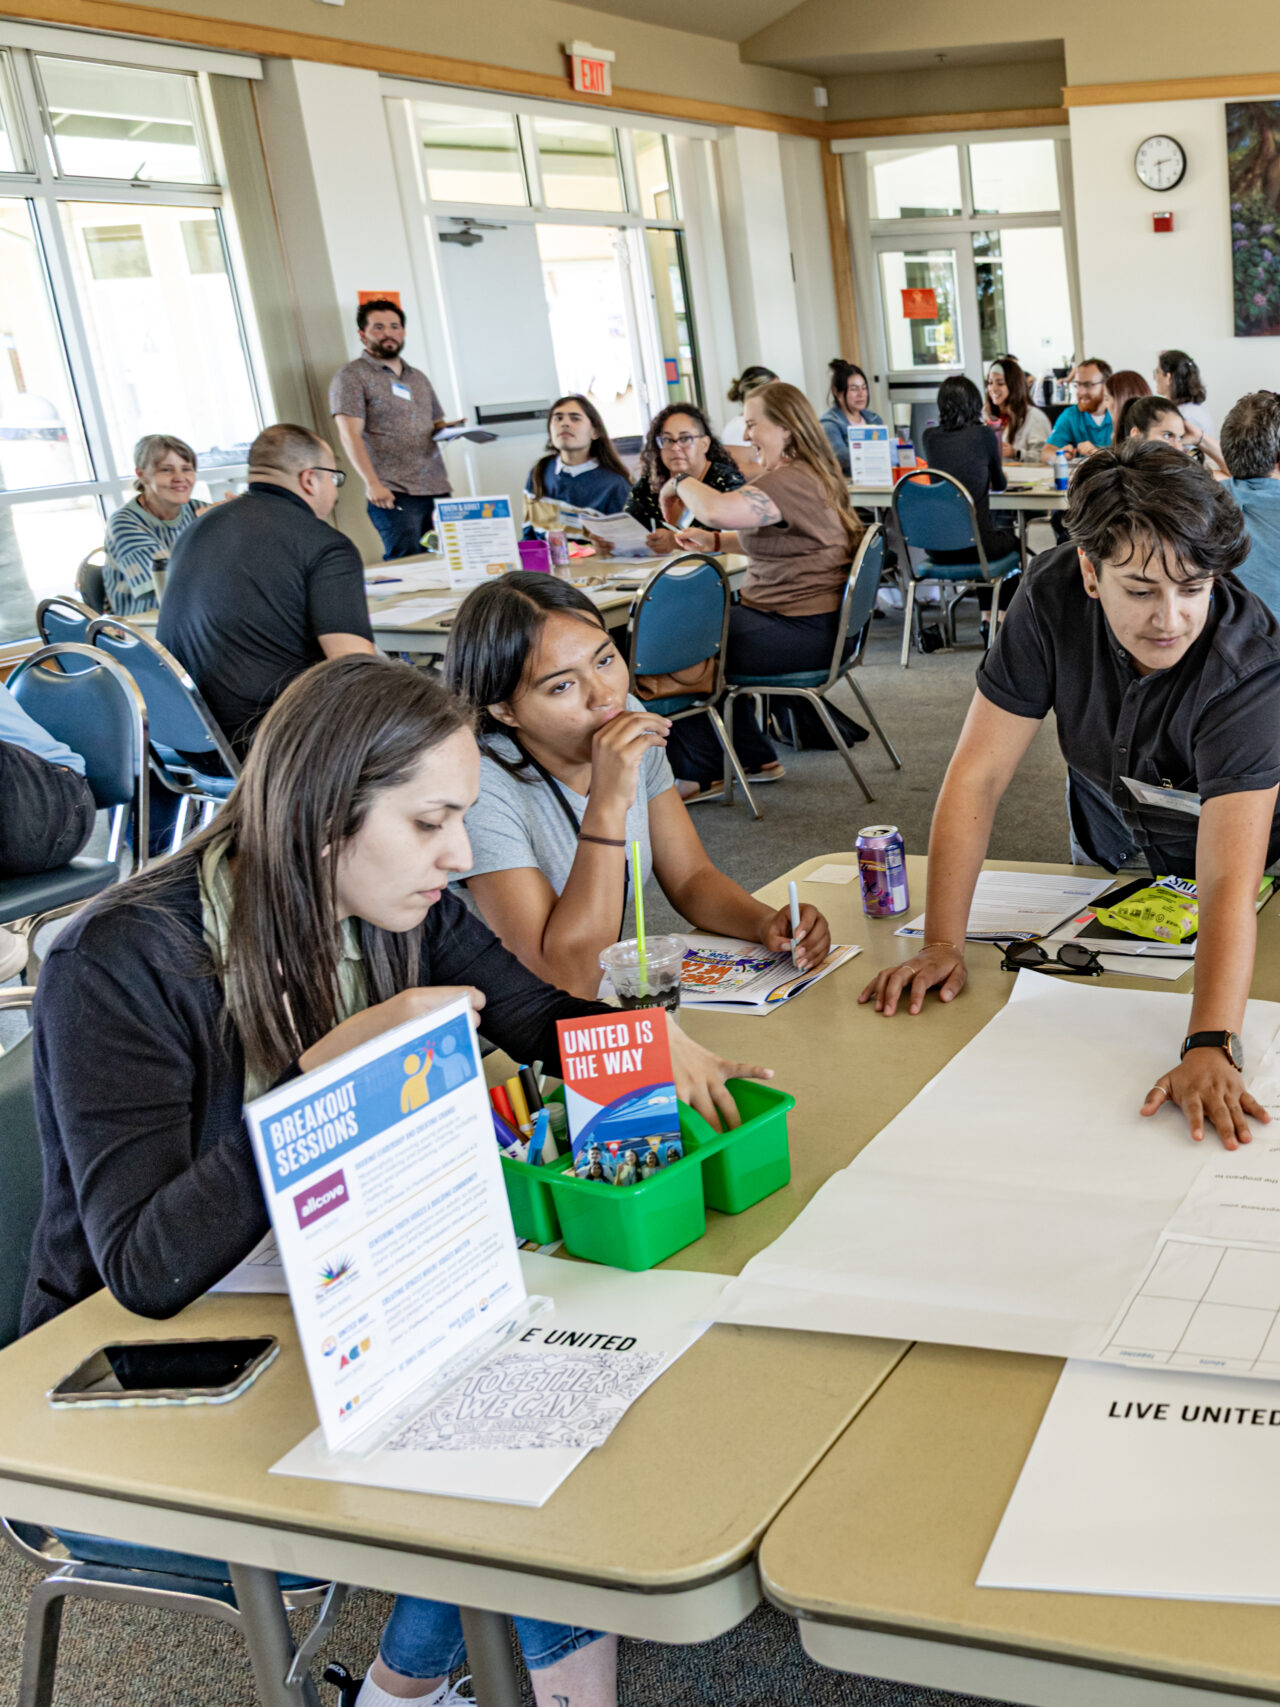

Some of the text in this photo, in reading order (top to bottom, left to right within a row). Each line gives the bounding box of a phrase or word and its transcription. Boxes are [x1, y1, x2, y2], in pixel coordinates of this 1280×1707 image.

[581, 60, 605, 93] EXIT
[687, 955, 738, 967] YAP SUMMIT
[708, 951, 734, 960] 2026
[563, 1020, 654, 1054] UNITED IS
[566, 1052, 643, 1081] THE WAY
[268, 1080, 358, 1150] BREAKOUT
[274, 1117, 359, 1177] SESSIONS
[300, 1182, 345, 1218] allcove
[544, 1329, 637, 1351] UNITED
[464, 1368, 618, 1395] TOGETHER
[456, 1393, 588, 1420] WE CAN
[1108, 1400, 1170, 1420] LIVE
